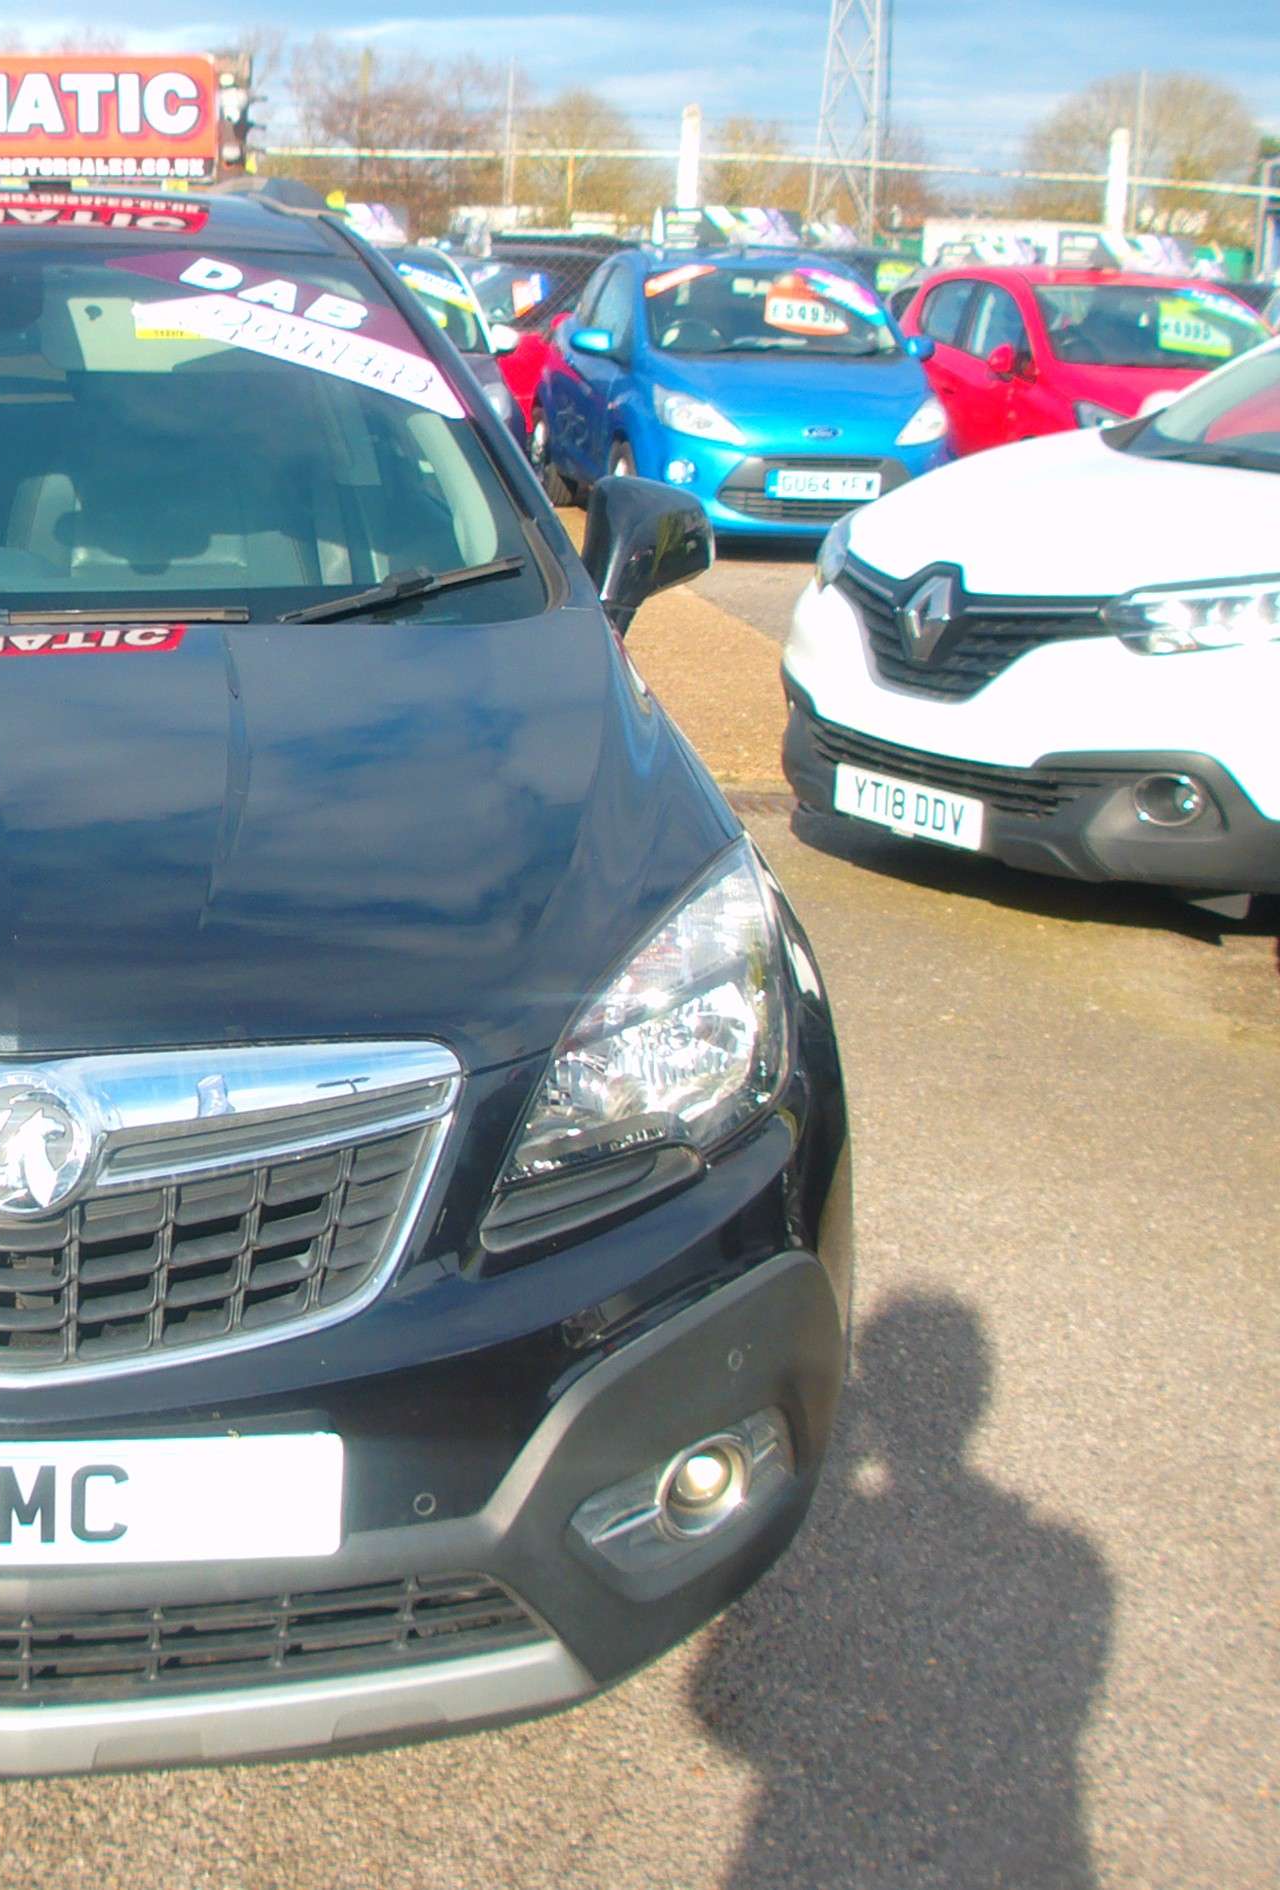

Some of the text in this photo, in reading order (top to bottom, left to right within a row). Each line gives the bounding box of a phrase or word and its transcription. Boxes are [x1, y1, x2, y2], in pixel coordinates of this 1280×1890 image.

[178, 256, 369, 330] DAB
[854, 775, 965, 836] YT18 DDV
